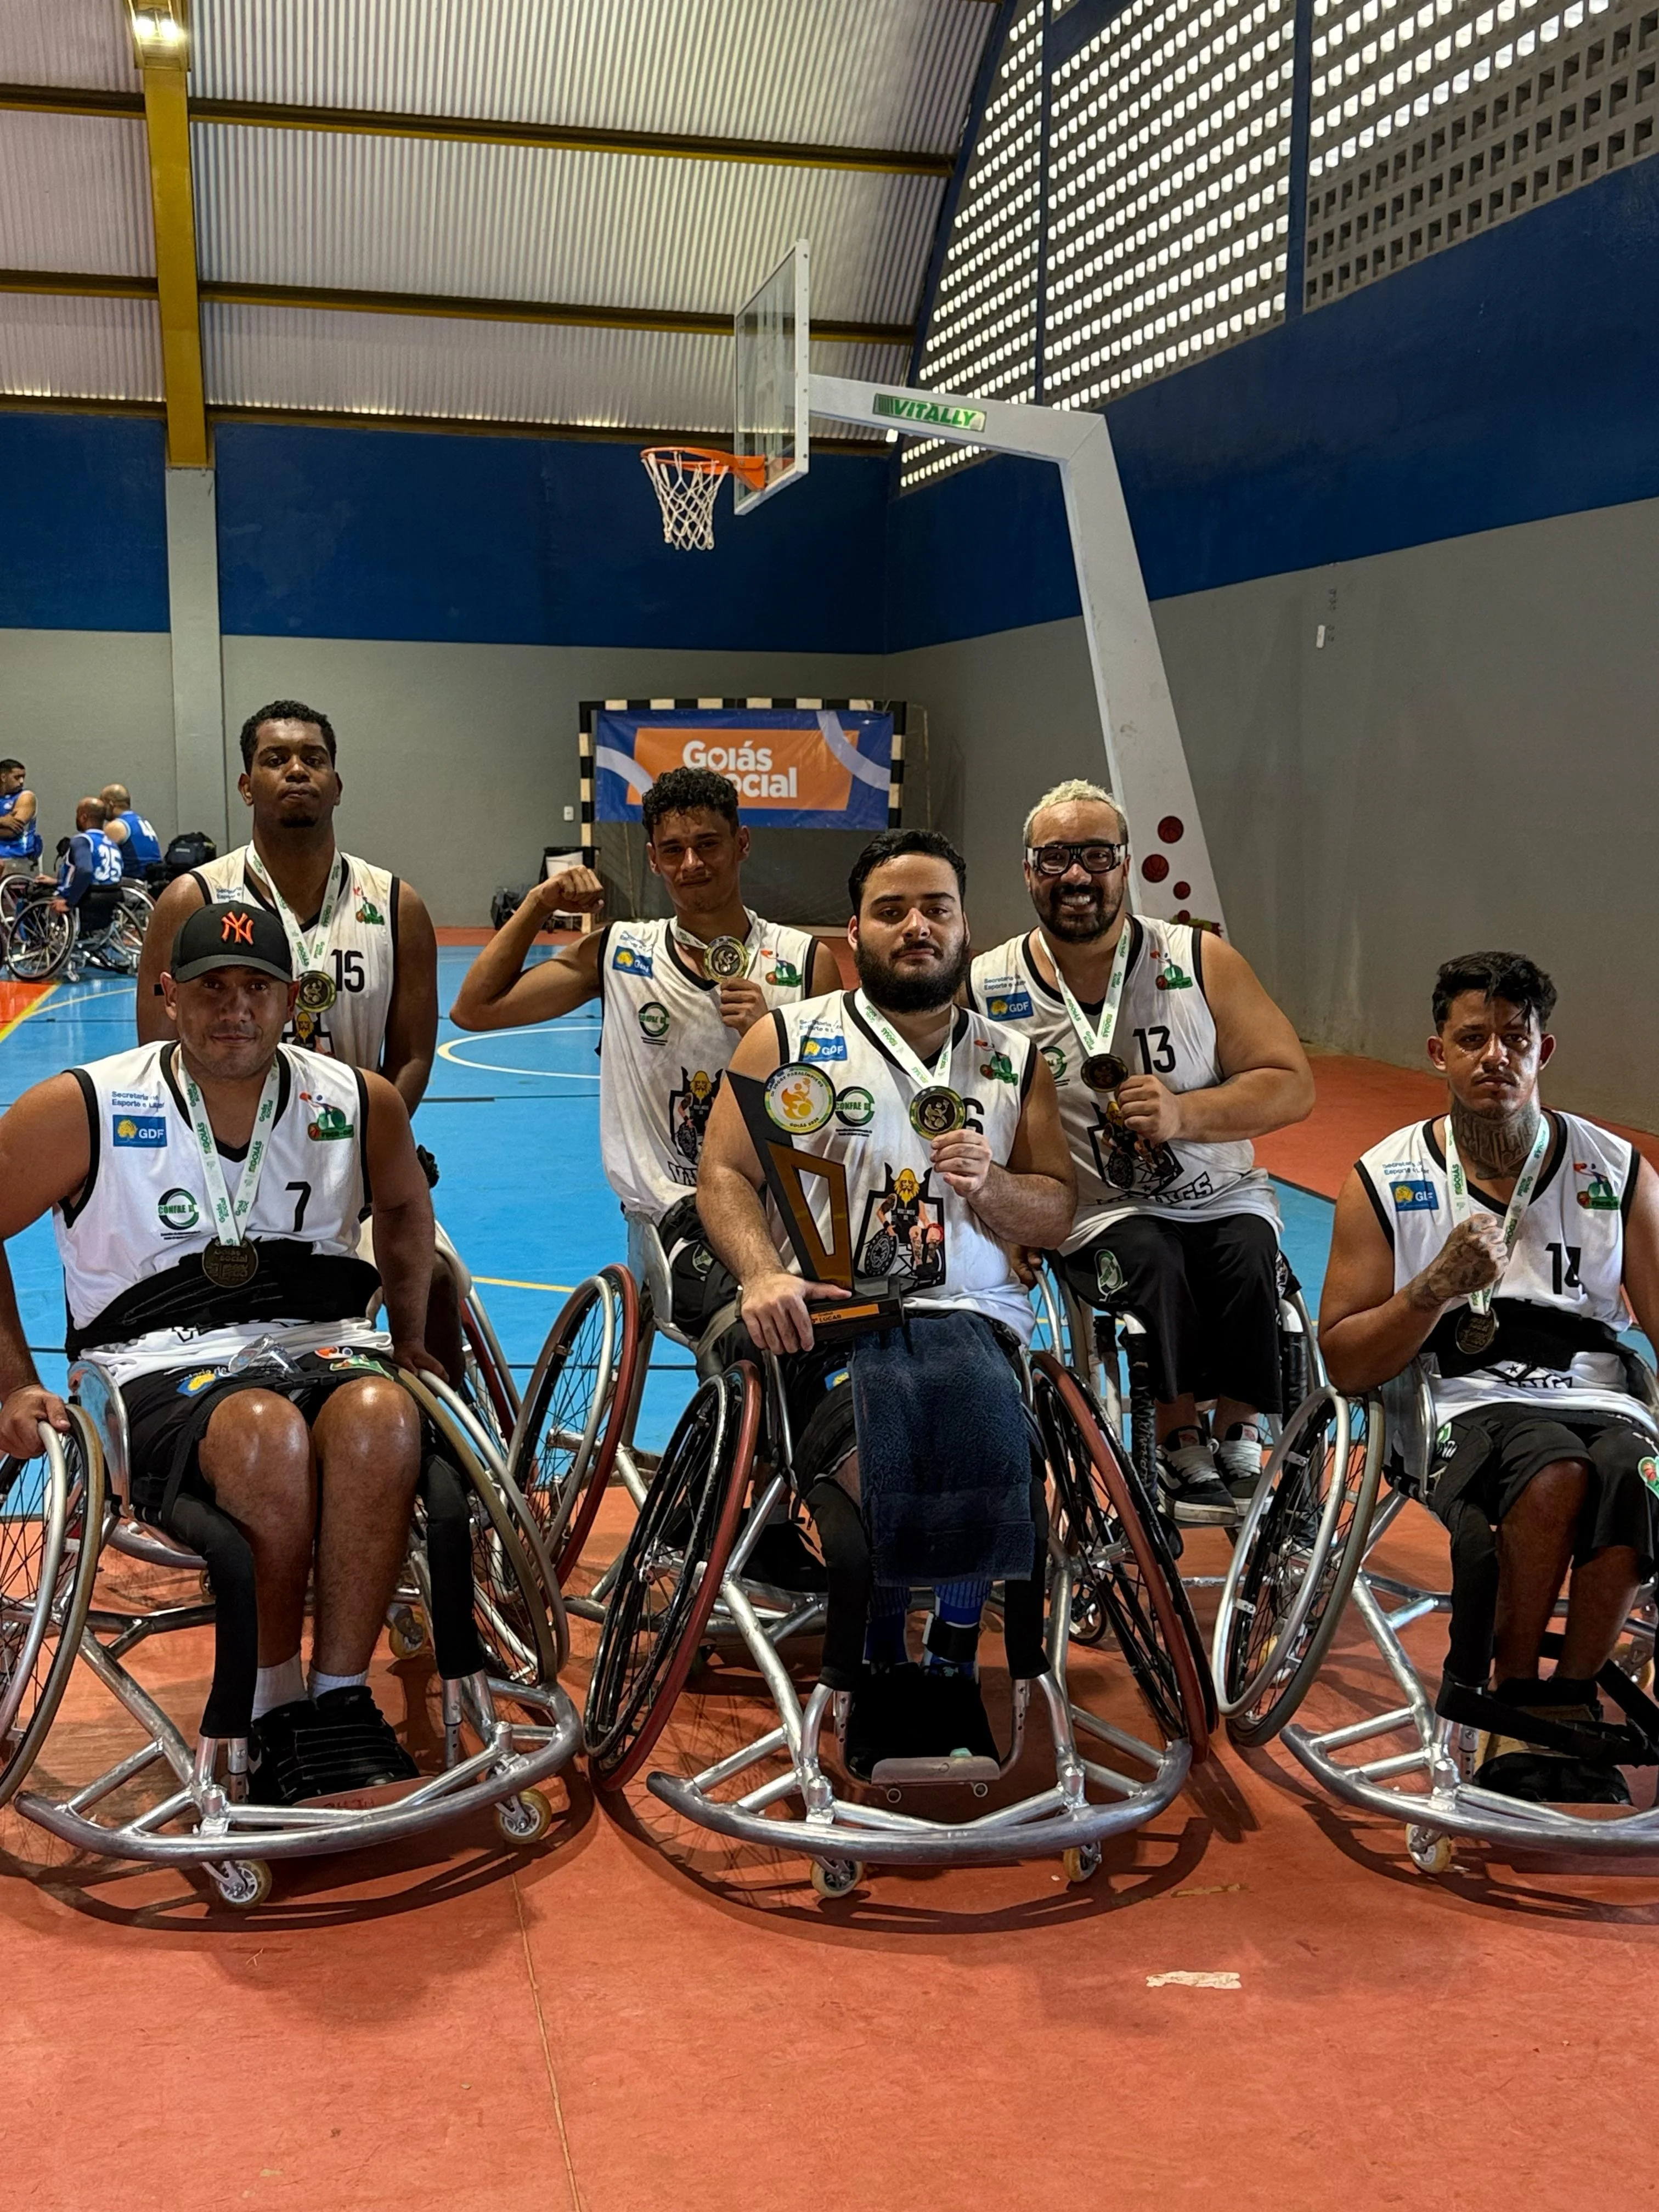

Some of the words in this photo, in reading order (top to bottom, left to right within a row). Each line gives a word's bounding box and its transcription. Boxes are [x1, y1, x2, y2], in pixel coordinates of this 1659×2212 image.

[894, 399, 977, 426] VITALLY
[682, 740, 773, 772] Goiás
[724, 766, 798, 798] ocial
[93, 843, 123, 885] 35
[221, 911, 255, 945] NY
[330, 949, 365, 994] 15
[1009, 1001, 1029, 1013] GDF
[821, 1045, 844, 1056] GDF
[1132, 1025, 1176, 1075] 13
[112, 1099, 141, 1107] Esporte
[138, 1128, 165, 1139] GDF
[197, 1122, 212, 1152] GOIÁS
[250, 1140, 263, 1169] GOIÁS
[285, 1181, 312, 1233] 7
[1545, 1243, 1586, 1295] 14
